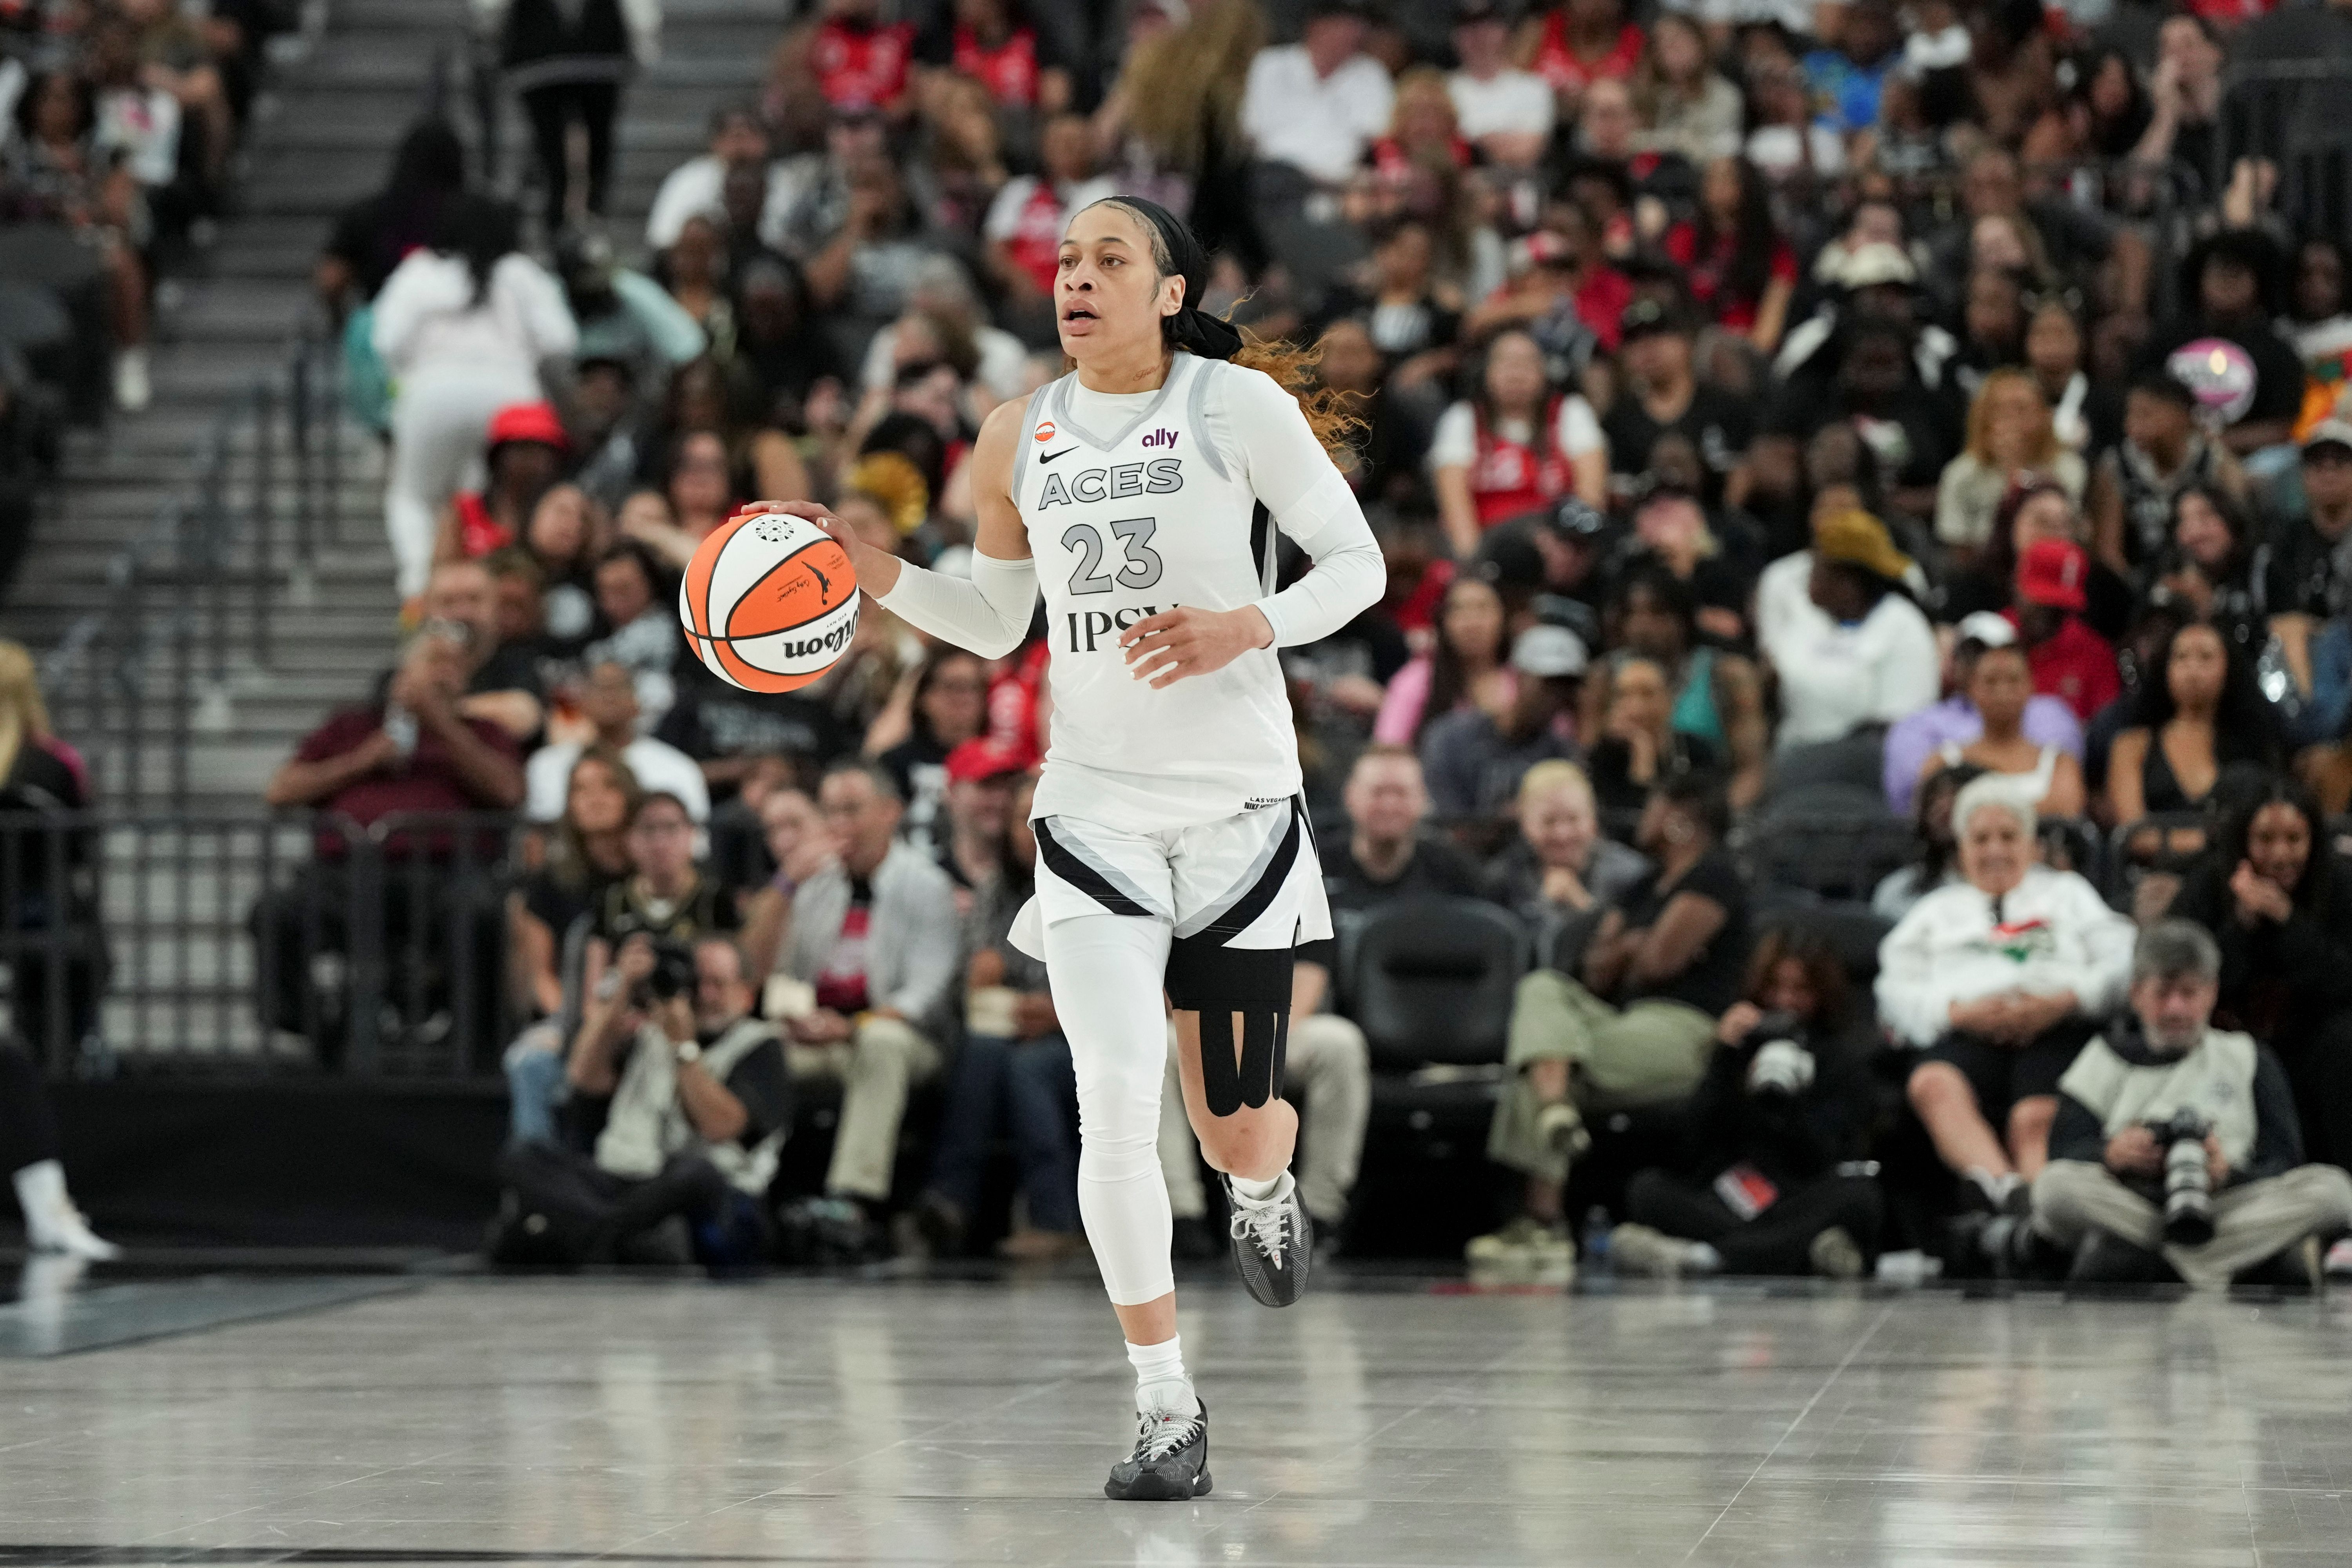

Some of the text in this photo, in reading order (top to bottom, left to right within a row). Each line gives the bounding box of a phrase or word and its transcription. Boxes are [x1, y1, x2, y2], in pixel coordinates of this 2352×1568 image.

[1142, 428, 1179, 449] ally
[1038, 458, 1183, 511] ACES
[1061, 517, 1163, 595] 23
[838, 613, 847, 621] EVO
[1244, 802, 1260, 810] NIKE
